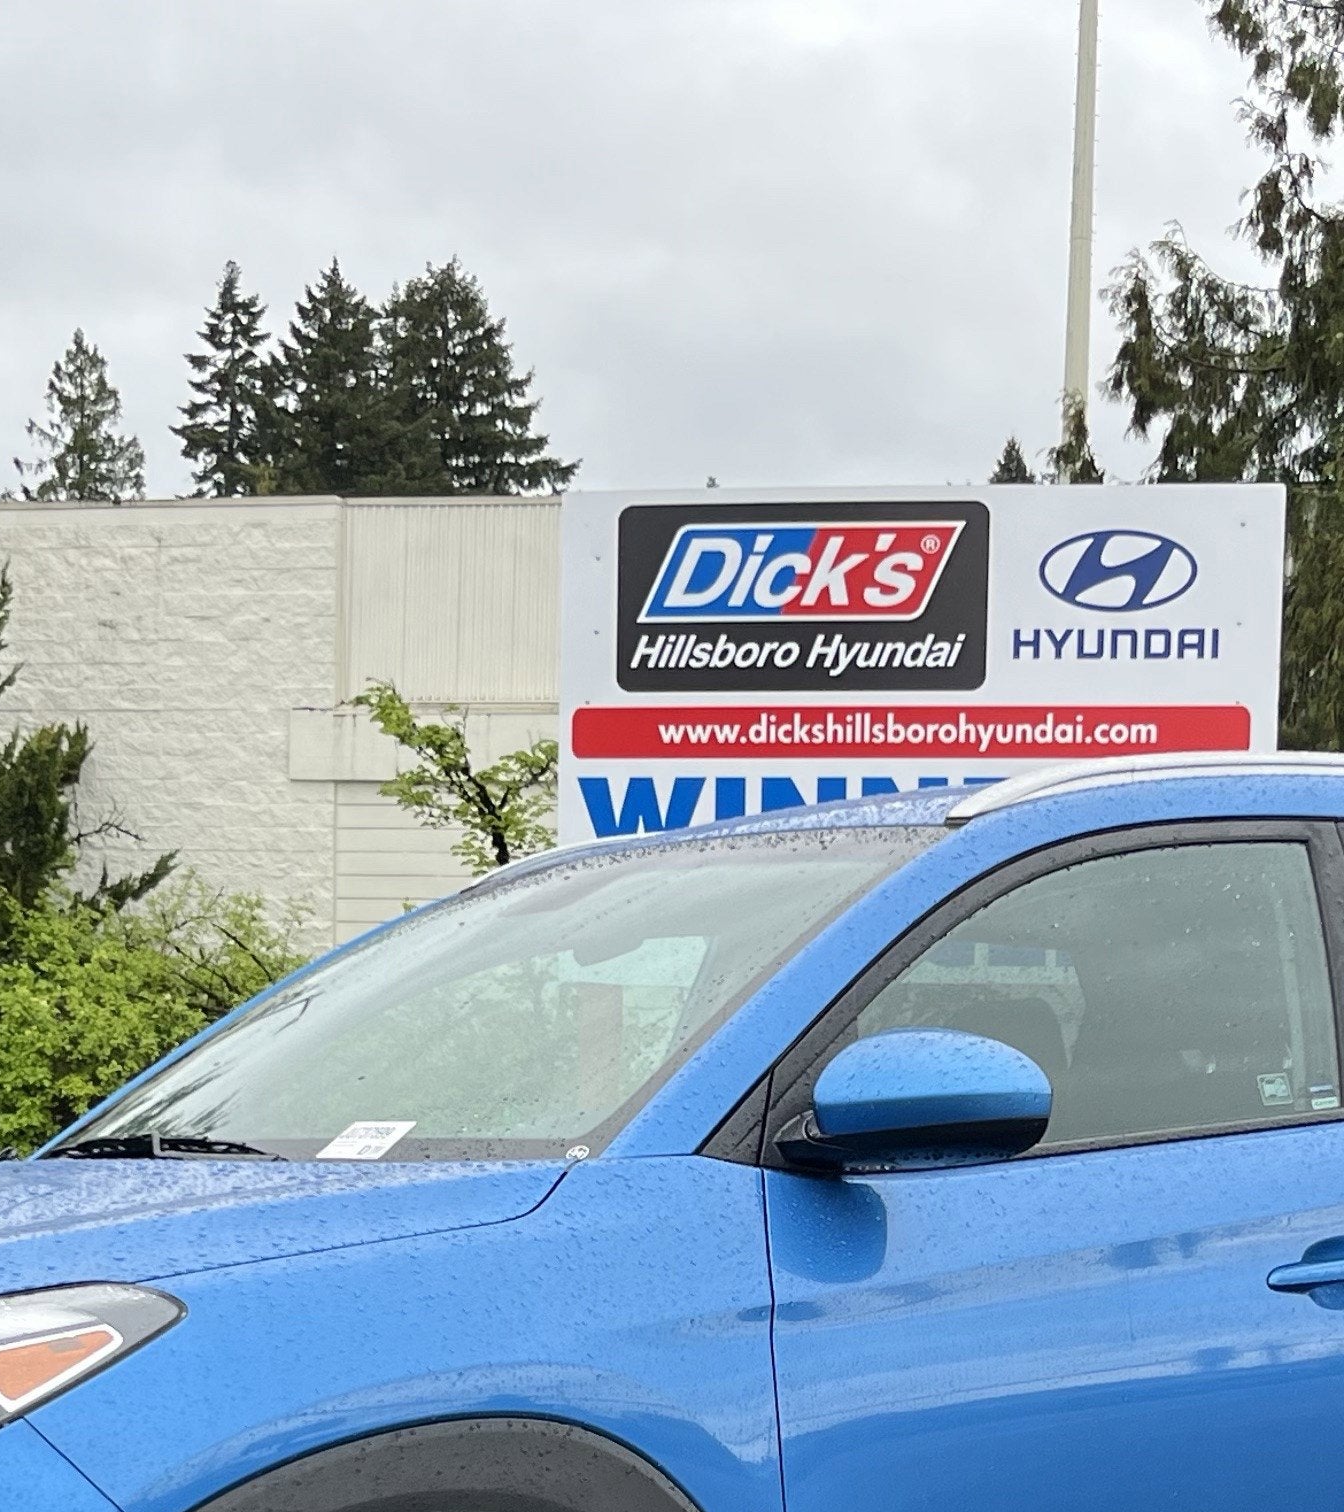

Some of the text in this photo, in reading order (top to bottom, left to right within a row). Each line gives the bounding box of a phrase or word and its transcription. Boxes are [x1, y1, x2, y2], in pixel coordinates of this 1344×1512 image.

[630, 633, 966, 677] Hillsboro Hyundai
[1013, 628, 1219, 660] HYUNDAI
[658, 713, 1158, 750] www.dickshillsborohyundai.com
